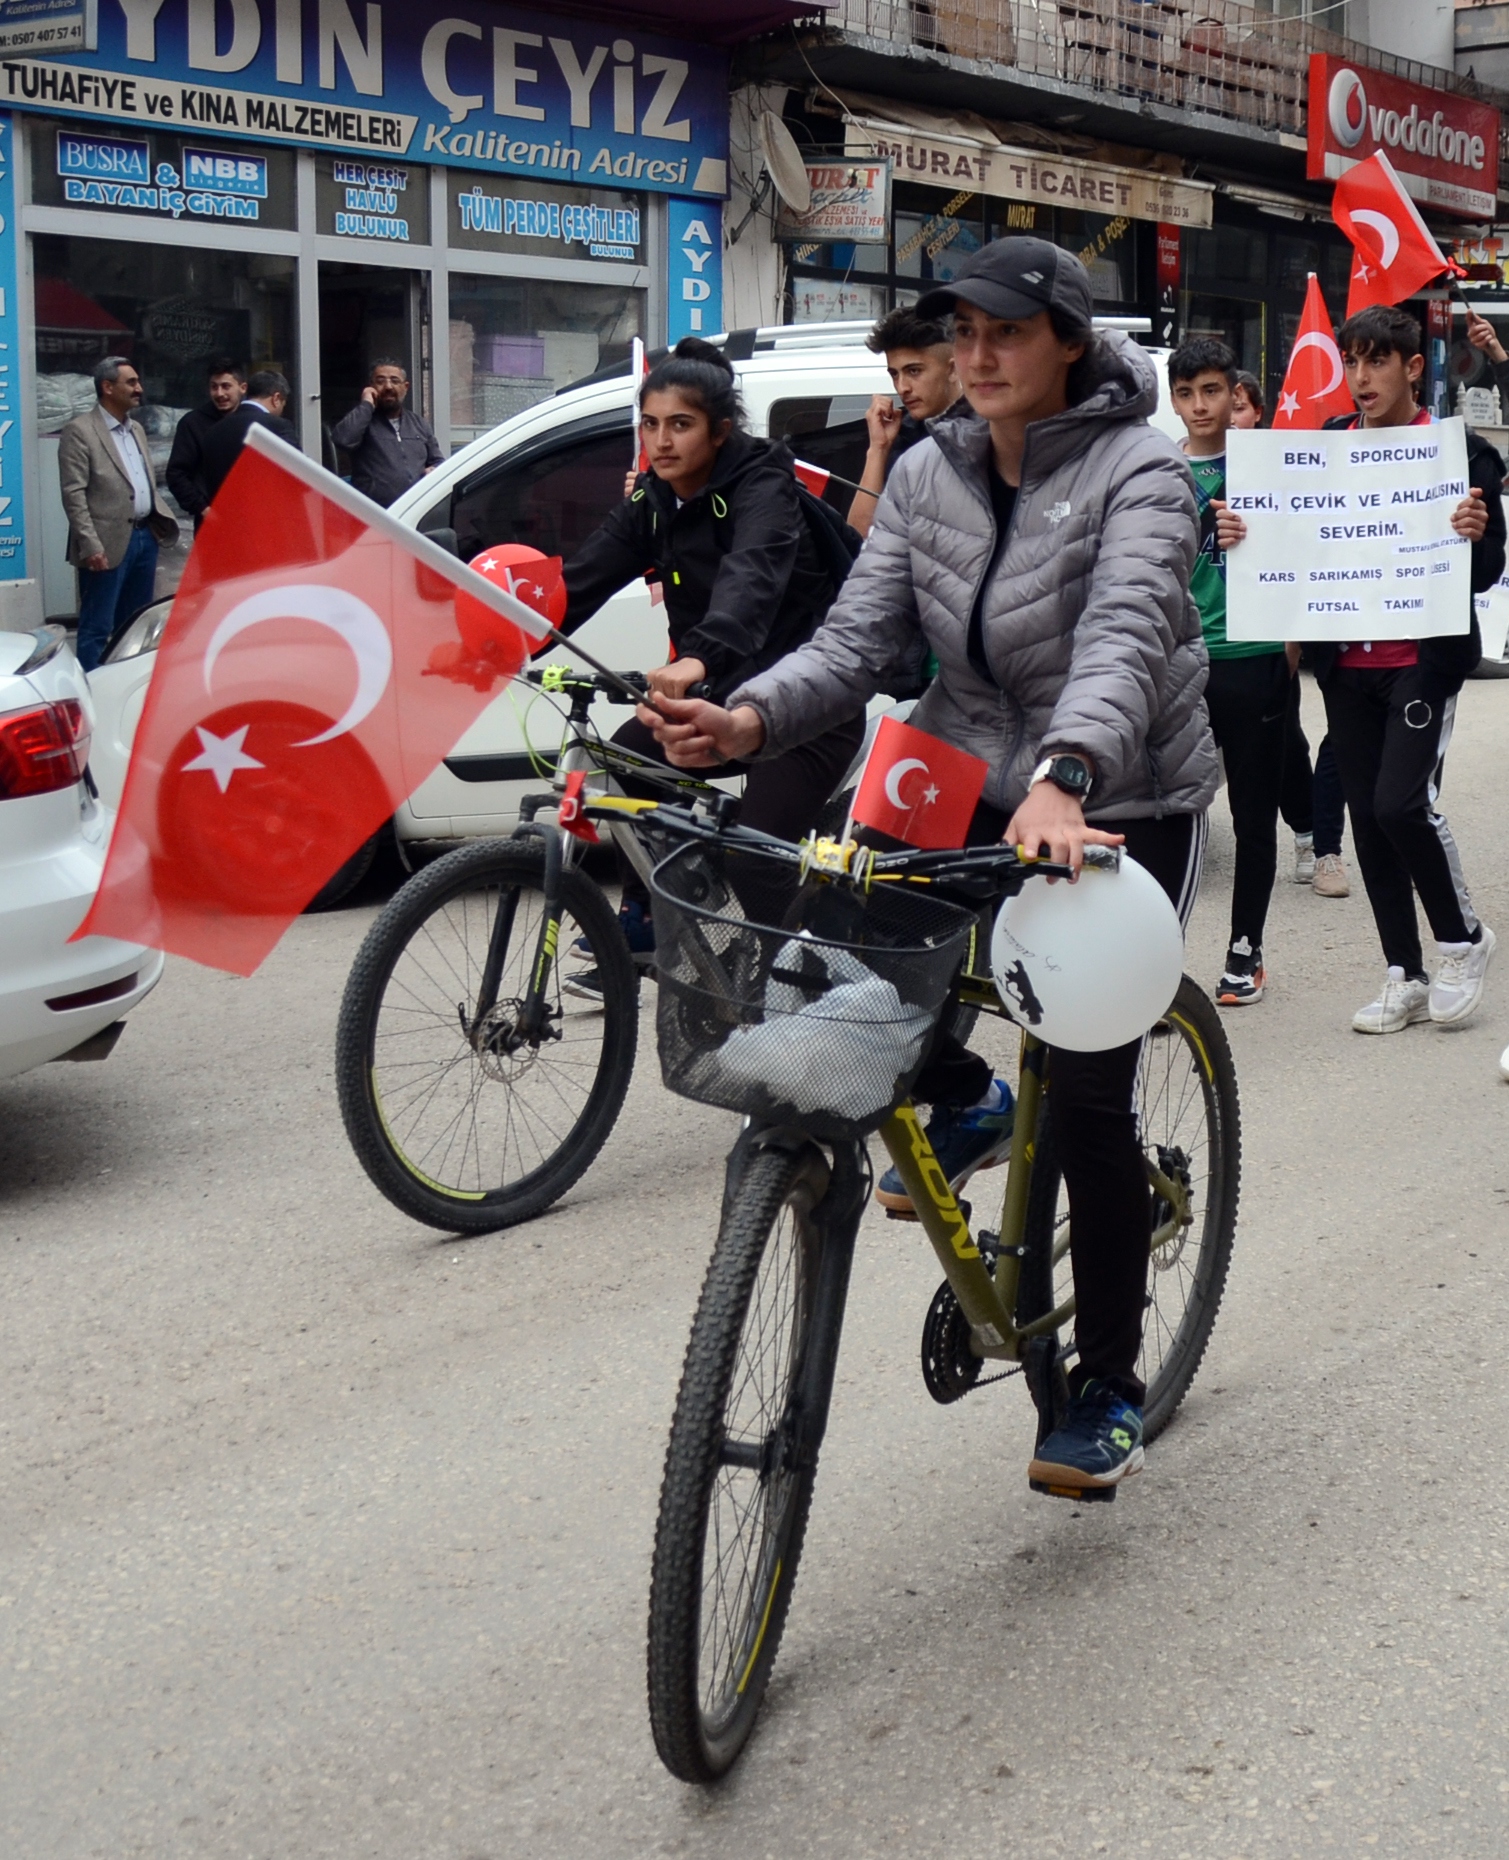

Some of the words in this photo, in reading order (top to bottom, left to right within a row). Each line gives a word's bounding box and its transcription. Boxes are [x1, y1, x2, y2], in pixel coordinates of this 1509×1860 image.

[12, 32, 35, 46] 0507
[37, 29, 55, 42] 407
[57, 27, 69, 40] 57
[71, 25, 82, 37] 41
[115, 0, 383, 96] YDIN
[144, 92, 174, 117] ve
[181, 89, 239, 126] KINA
[1368, 104, 1485, 171] vodafone
[423, 123, 582, 171] Kalitenin
[588, 148, 689, 184] Adresi
[155, 162, 181, 189] &
[190, 156, 259, 182] NBB
[334, 161, 366, 185] HER
[806, 168, 880, 190] URT
[875, 140, 991, 182] MURAT
[1009, 162, 1133, 206] TİCARET
[65, 179, 158, 209] BAYAN
[191, 176, 259, 191] Lingerie
[346, 188, 397, 214] HAVLU
[459, 187, 502, 233] TÜM
[504, 198, 560, 239] PERDE
[336, 211, 410, 241] BULUNUR
[590, 244, 635, 260] BULUNUR
[681, 219, 713, 332] AYDI
[1284, 452, 1326, 468] BEN,
[1230, 494, 1280, 512] ZEKİ,
[1290, 492, 1347, 512] ÇEVİK
[1358, 494, 1381, 508] VE
[1320, 520, 1404, 540] SEVERİM.
[1259, 572, 1296, 583] KARS
[1309, 568, 1383, 582] SARIKAMIŞ
[1396, 566, 1426, 579] SPOR
[1307, 602, 1360, 613] FUTSAL
[894, 1107, 981, 1259] RON
